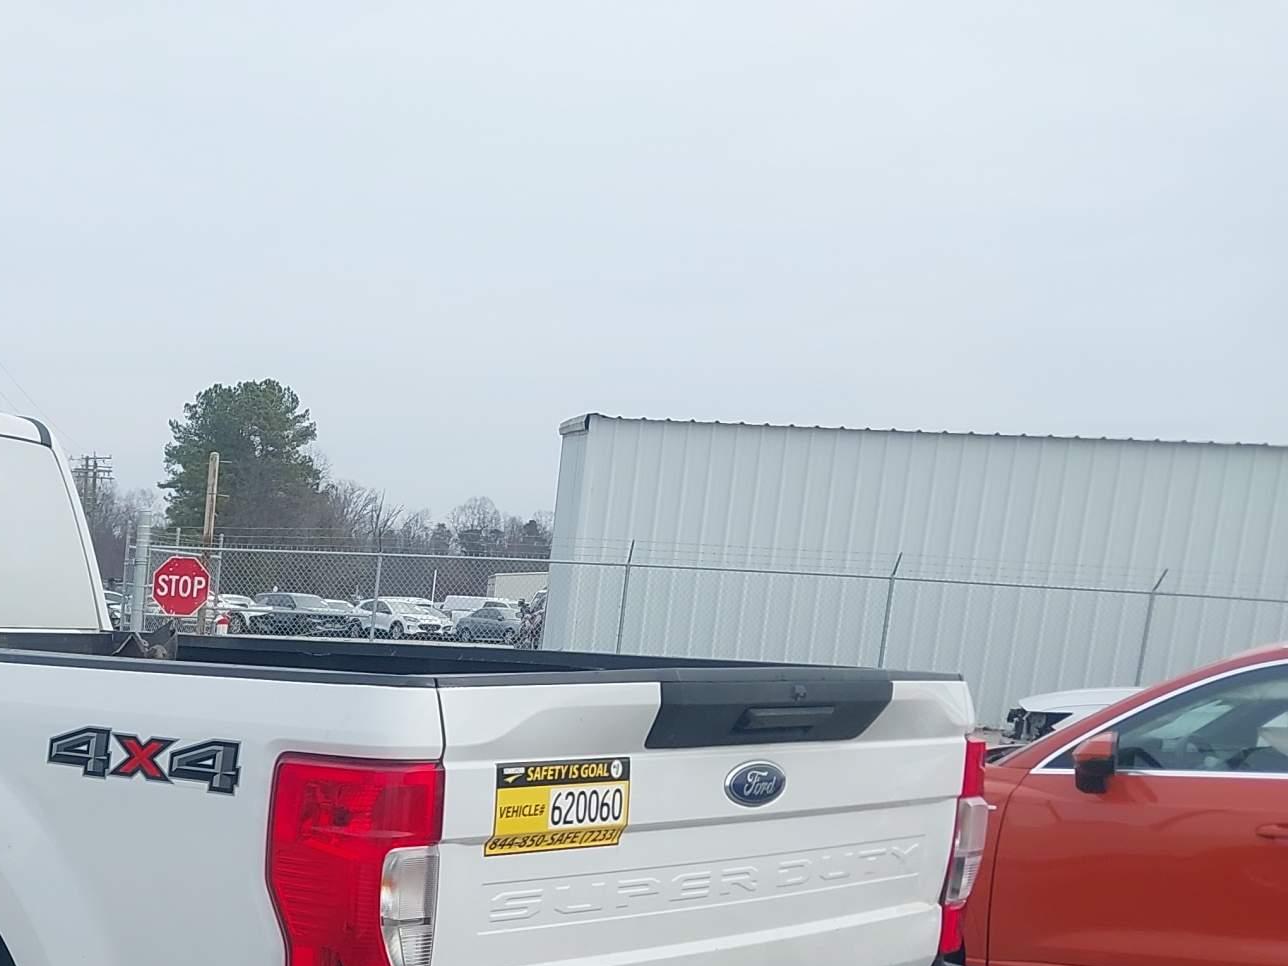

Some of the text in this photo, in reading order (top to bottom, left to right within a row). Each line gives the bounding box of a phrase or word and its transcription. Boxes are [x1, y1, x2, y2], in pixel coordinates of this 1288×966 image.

[156, 575, 206, 598] STOP
[527, 765, 568, 781] SAFETY
[569, 764, 579, 779] IS
[580, 763, 610, 778] GOAL
[744, 770, 777, 796] Ford
[551, 788, 623, 826] 620060
[488, 842, 921, 923] SUPER DUTY
